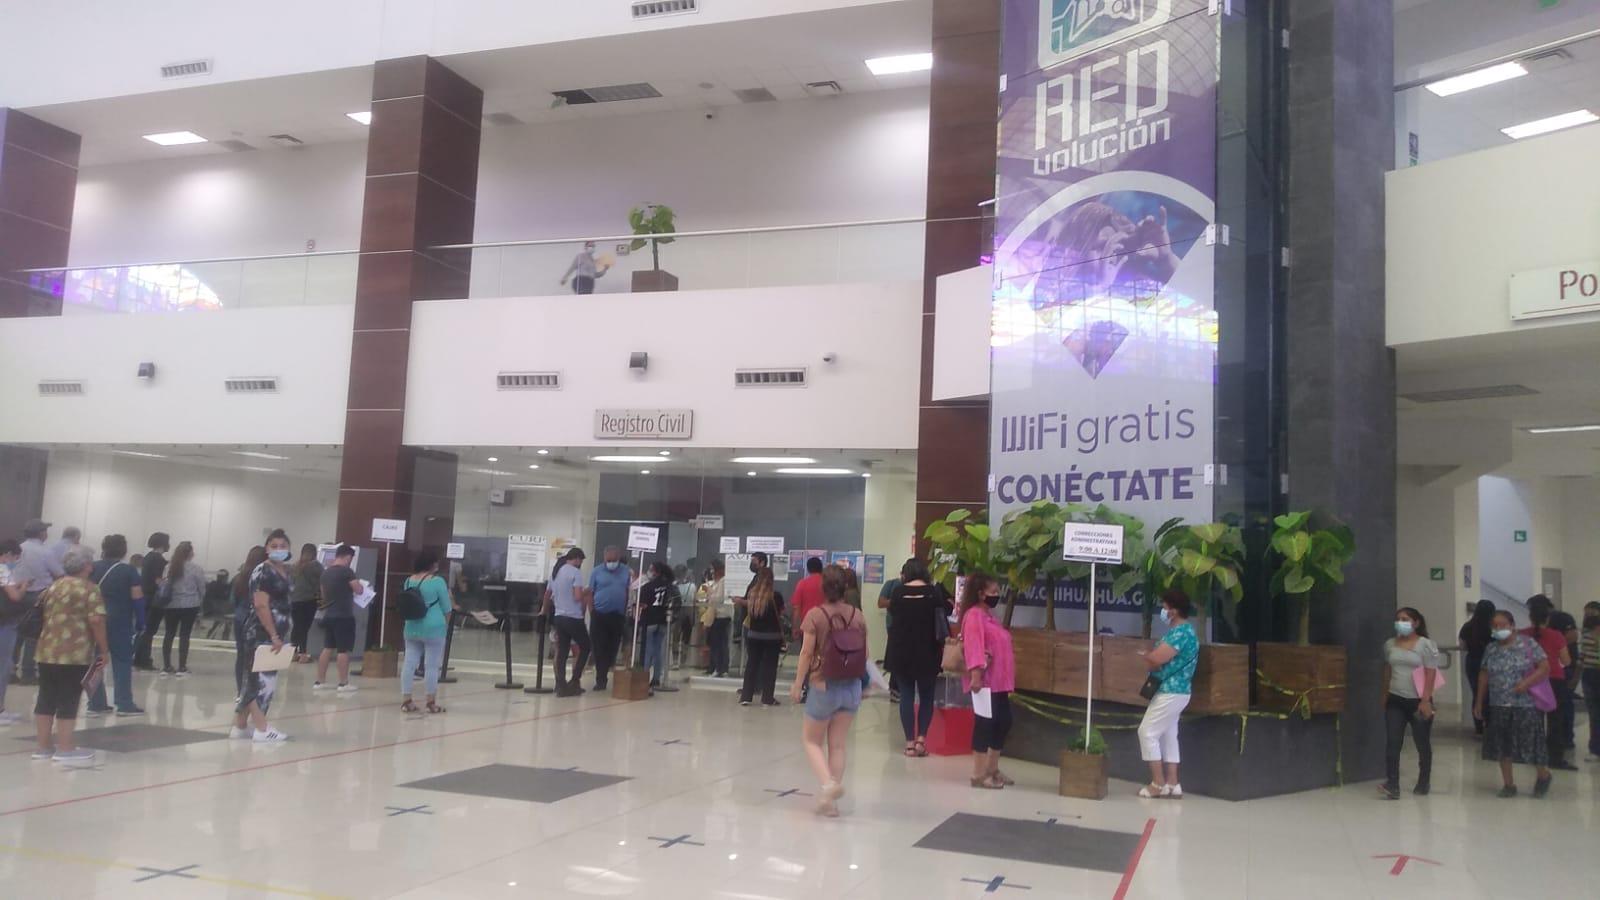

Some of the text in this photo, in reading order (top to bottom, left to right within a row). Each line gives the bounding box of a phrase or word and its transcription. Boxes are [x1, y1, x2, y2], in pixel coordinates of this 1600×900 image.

[1035, 39, 1170, 151] RED
[601, 413, 686, 436] Registro Civil
[1001, 400, 1195, 454] WiFi gratis
[997, 464, 1194, 505] CONÉCTATE
